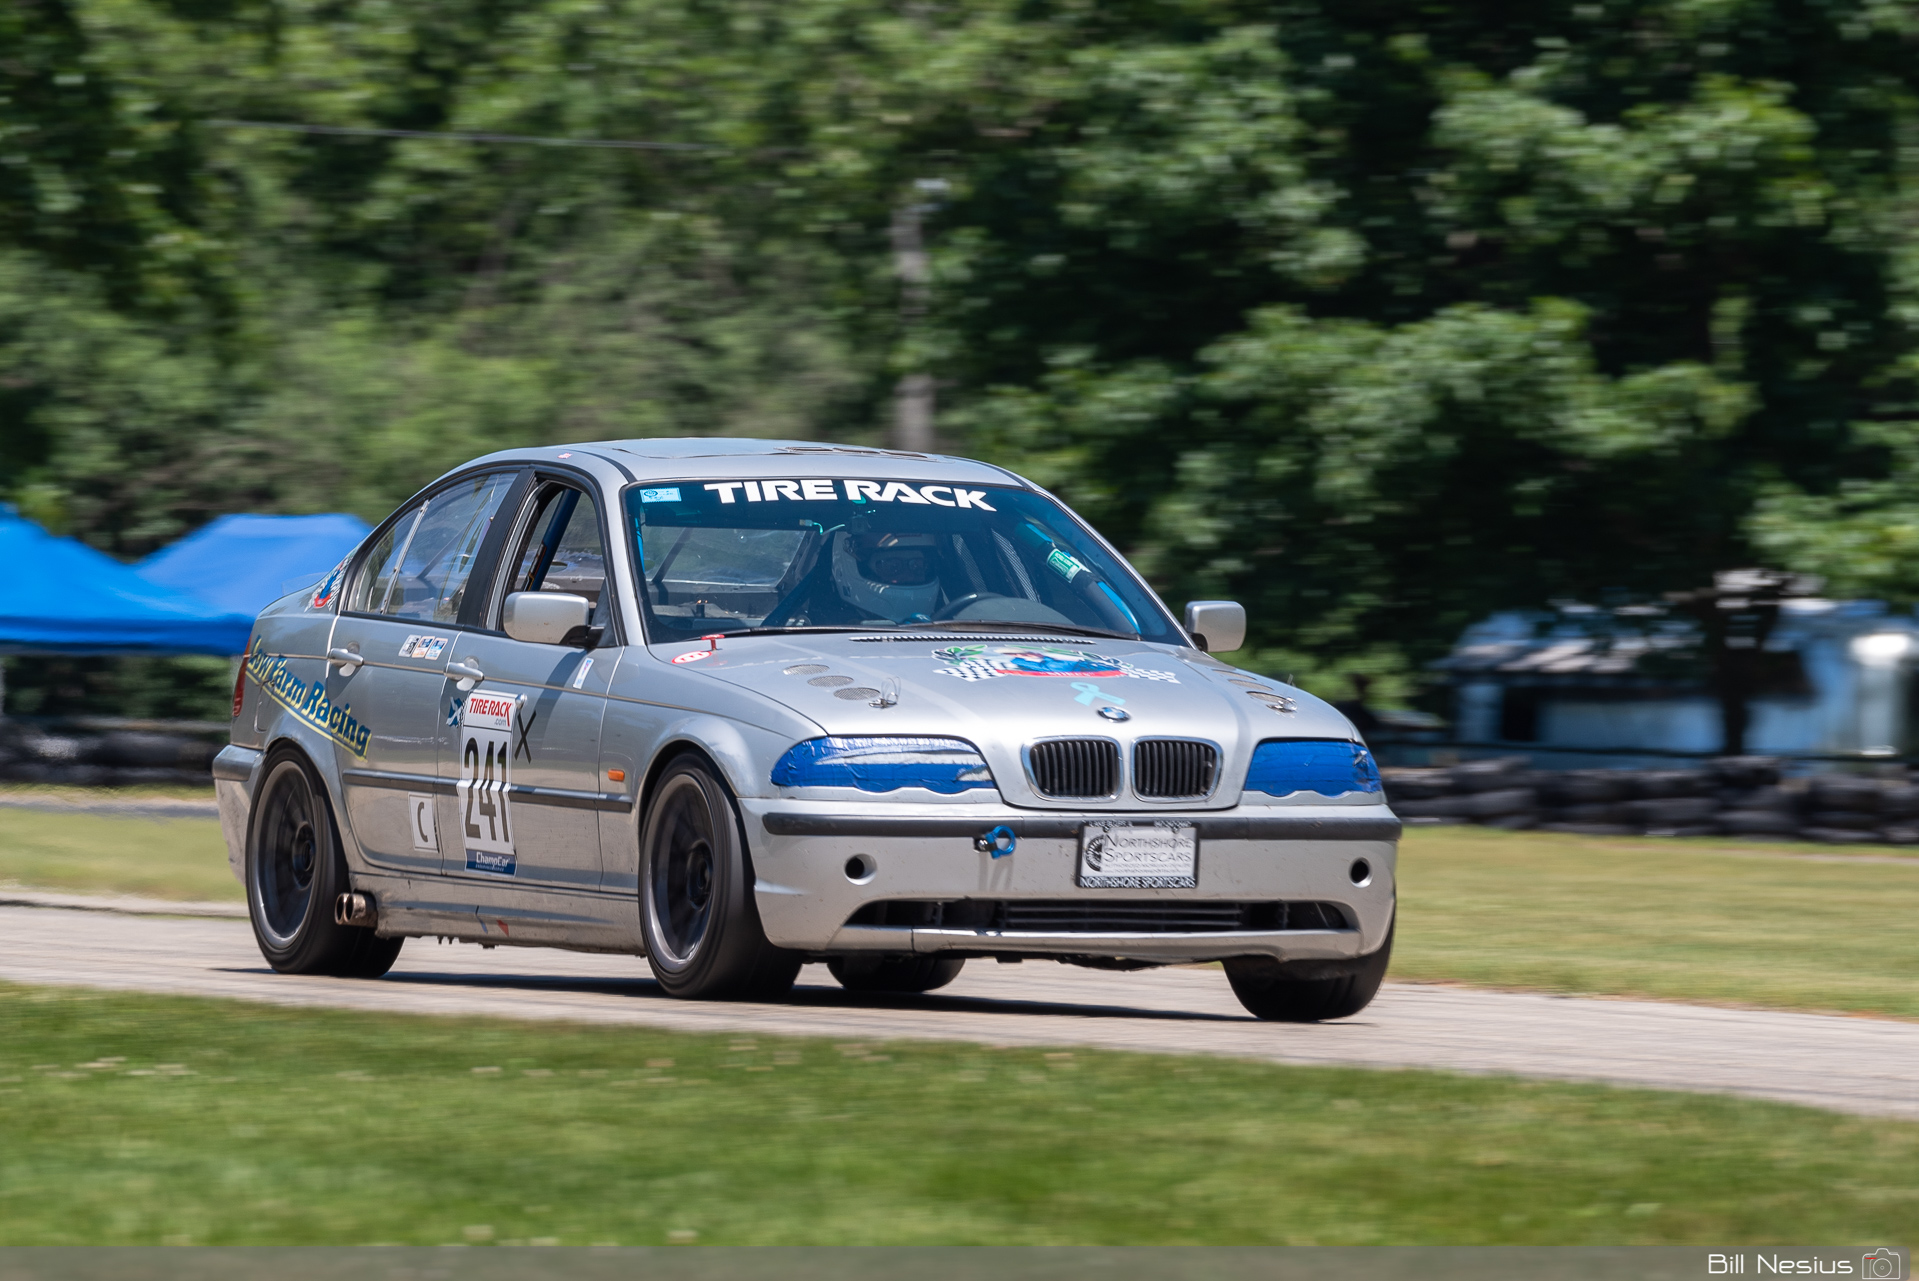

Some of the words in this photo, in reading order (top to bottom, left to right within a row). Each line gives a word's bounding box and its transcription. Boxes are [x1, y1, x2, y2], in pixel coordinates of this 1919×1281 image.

[703, 479, 838, 504] TIRE
[843, 479, 997, 512] RACK
[301, 681, 372, 759] Racing
[469, 698, 488, 715] TIRE
[487, 700, 512, 727] RACK
[464, 737, 509, 842] 241
[417, 801, 428, 842] C
[1103, 834, 1193, 849] NORTHSHORE
[1103, 847, 1193, 862] SPORTSCARS
[476, 851, 509, 868] ChampCar
[1080, 876, 1142, 888] NORTHSHORE
[1143, 876, 1196, 888] SPORTSCARS
